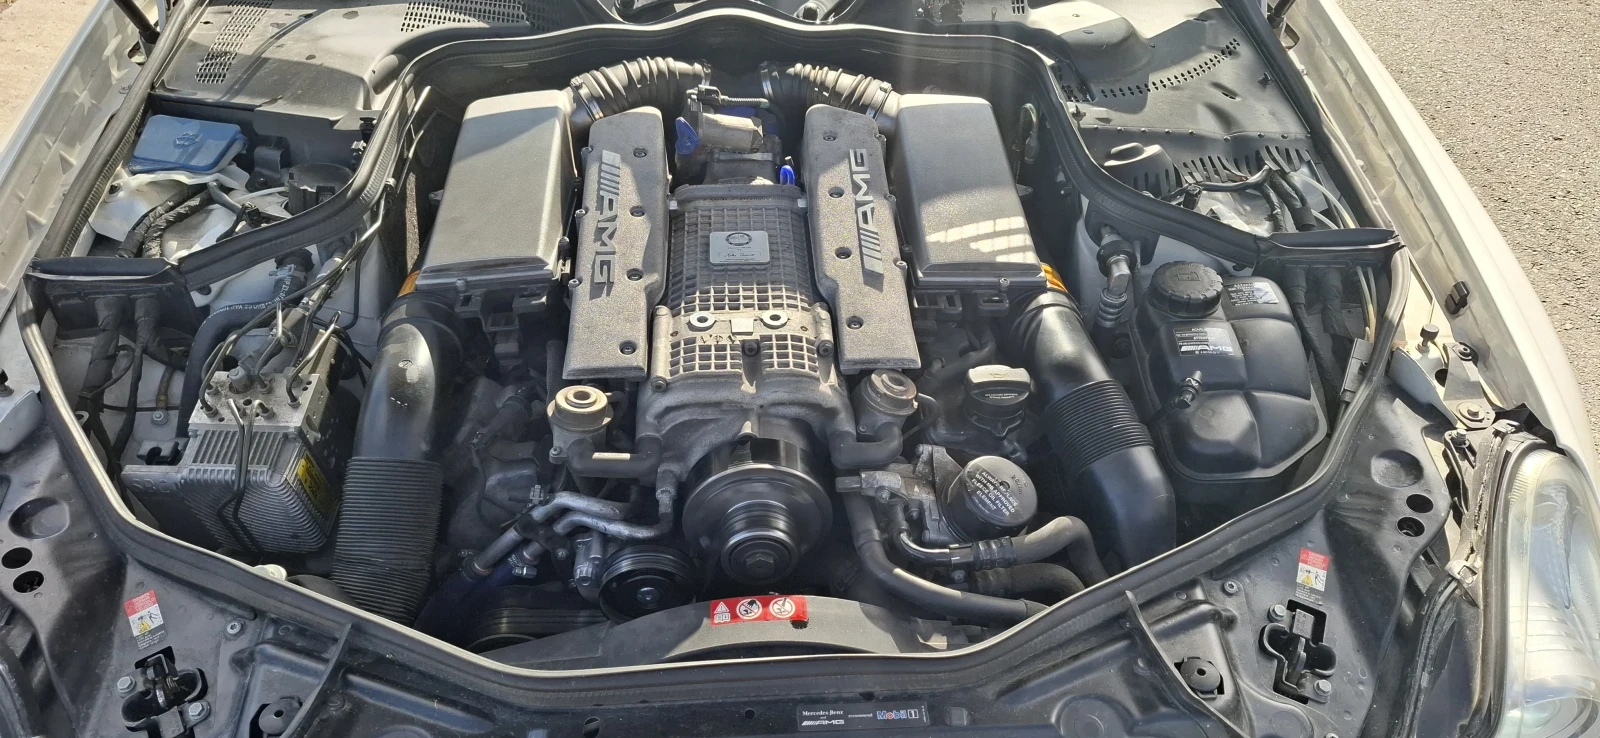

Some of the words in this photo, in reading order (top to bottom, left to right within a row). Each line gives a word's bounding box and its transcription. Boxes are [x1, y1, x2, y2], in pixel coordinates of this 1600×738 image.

[850, 148, 878, 232] AMG
[594, 194, 619, 283] AMG
[971, 478, 989, 494] FLEECE
[988, 492, 996, 502] OIL
[995, 500, 1010, 517] FILTER
[975, 473, 988, 484] WITH
[993, 489, 1015, 513] APPROVED
[976, 490, 997, 511] ELEMENT
[876, 709, 907, 720] Mobil
